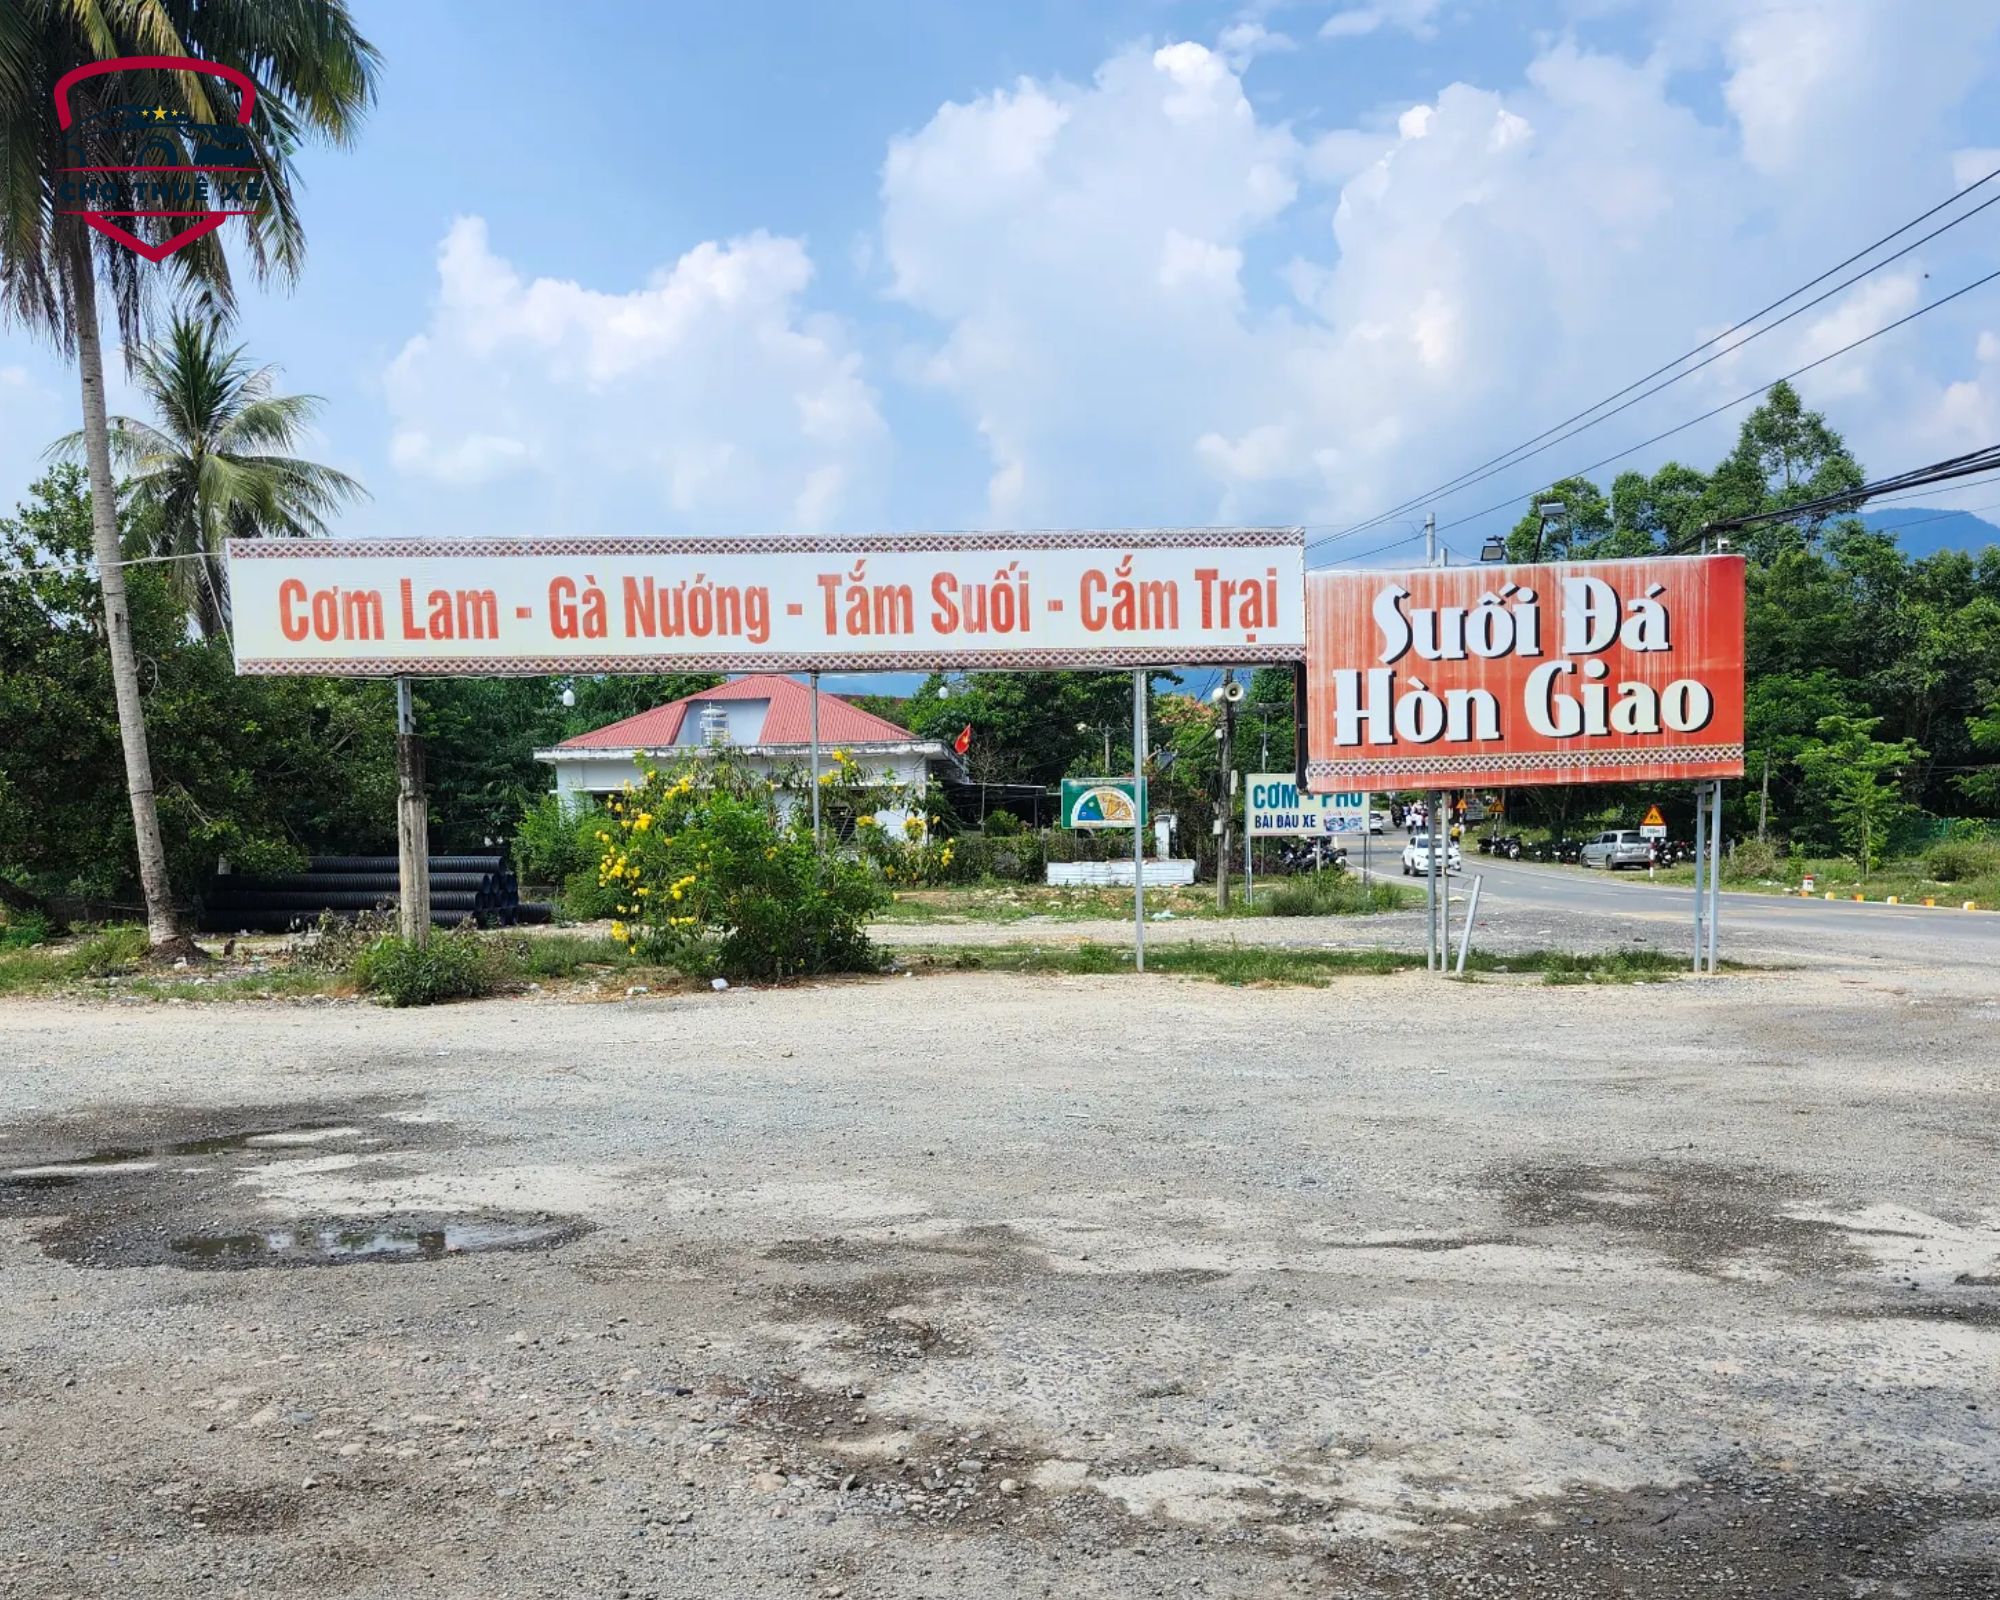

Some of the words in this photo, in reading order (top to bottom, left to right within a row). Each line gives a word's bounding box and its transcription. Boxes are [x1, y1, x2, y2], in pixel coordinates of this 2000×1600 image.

[278, 578, 385, 642] Cơm
[400, 578, 499, 641] Lam
[548, 574, 608, 640] Gà
[623, 572, 770, 645] Nướng
[817, 558, 914, 636] Tắm
[931, 560, 1031, 635] Suối
[1079, 554, 1179, 633] Cắm
[1194, 567, 1278, 643] Trại
[1373, 582, 1542, 665] Suối
[1562, 577, 1671, 656] Đá
[1333, 668, 1504, 746] Hòn
[1524, 659, 1714, 738] Giao
[1252, 781, 1300, 809] CƠM
[1255, 811, 1273, 828] BÃI
[1302, 814, 1317, 828] XE
